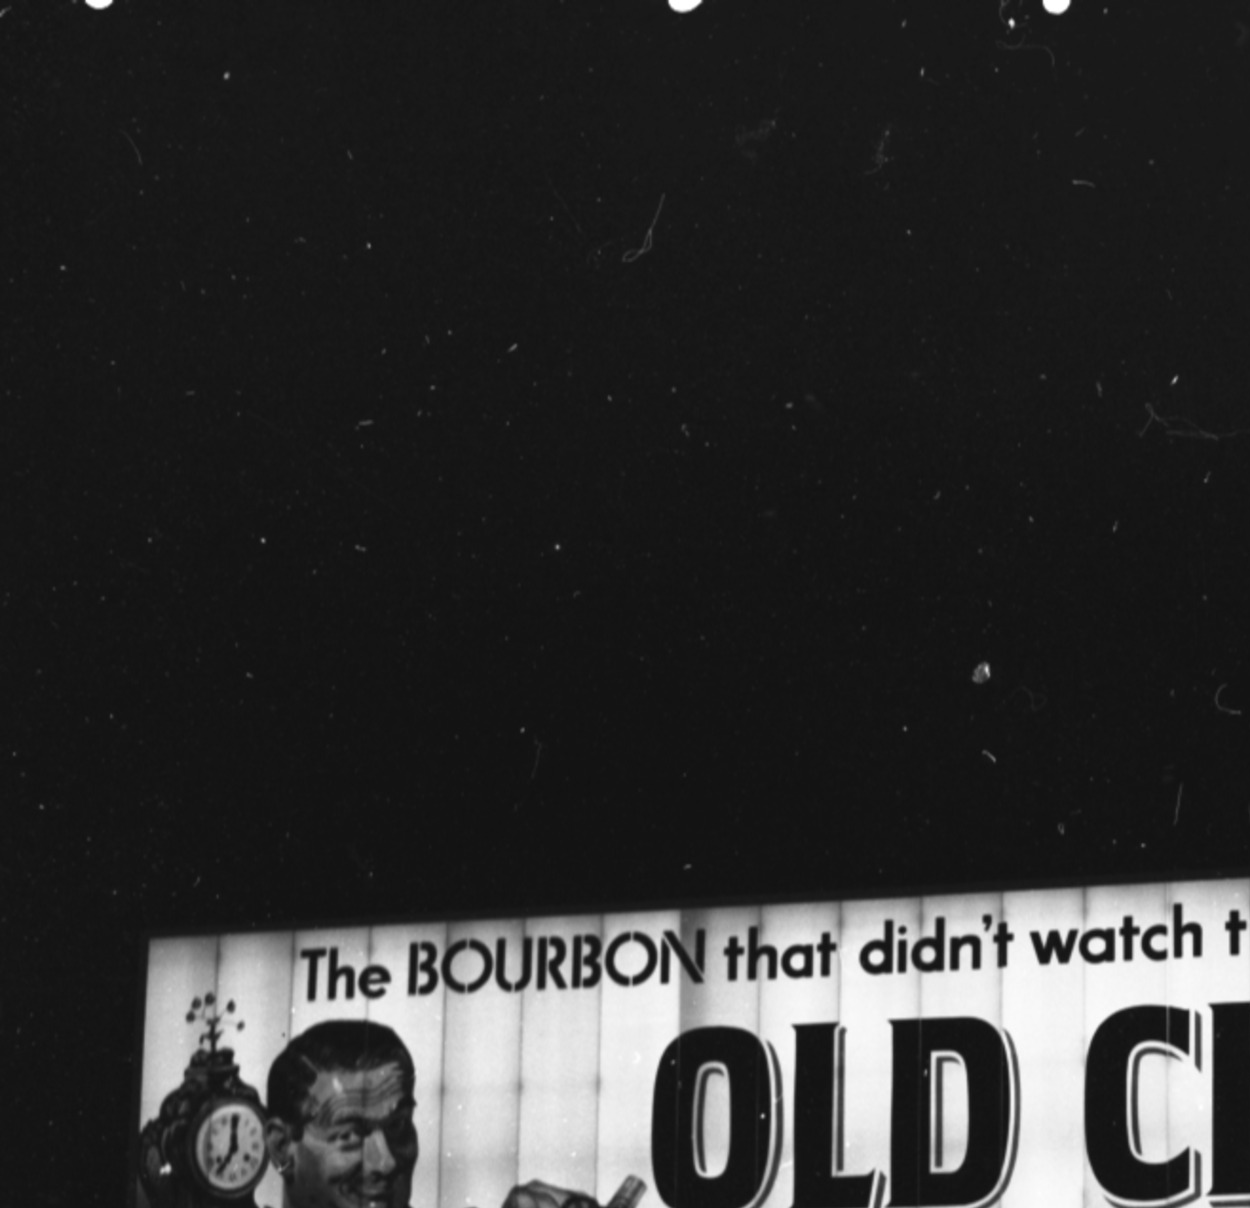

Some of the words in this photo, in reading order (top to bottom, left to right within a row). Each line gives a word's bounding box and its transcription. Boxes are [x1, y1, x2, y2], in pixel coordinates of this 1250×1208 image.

[300, 946, 392, 1001] The
[407, 928, 706, 996] BOURBON
[723, 926, 838, 982] that
[858, 912, 1014, 976] didn't
[1029, 902, 1203, 965] watch
